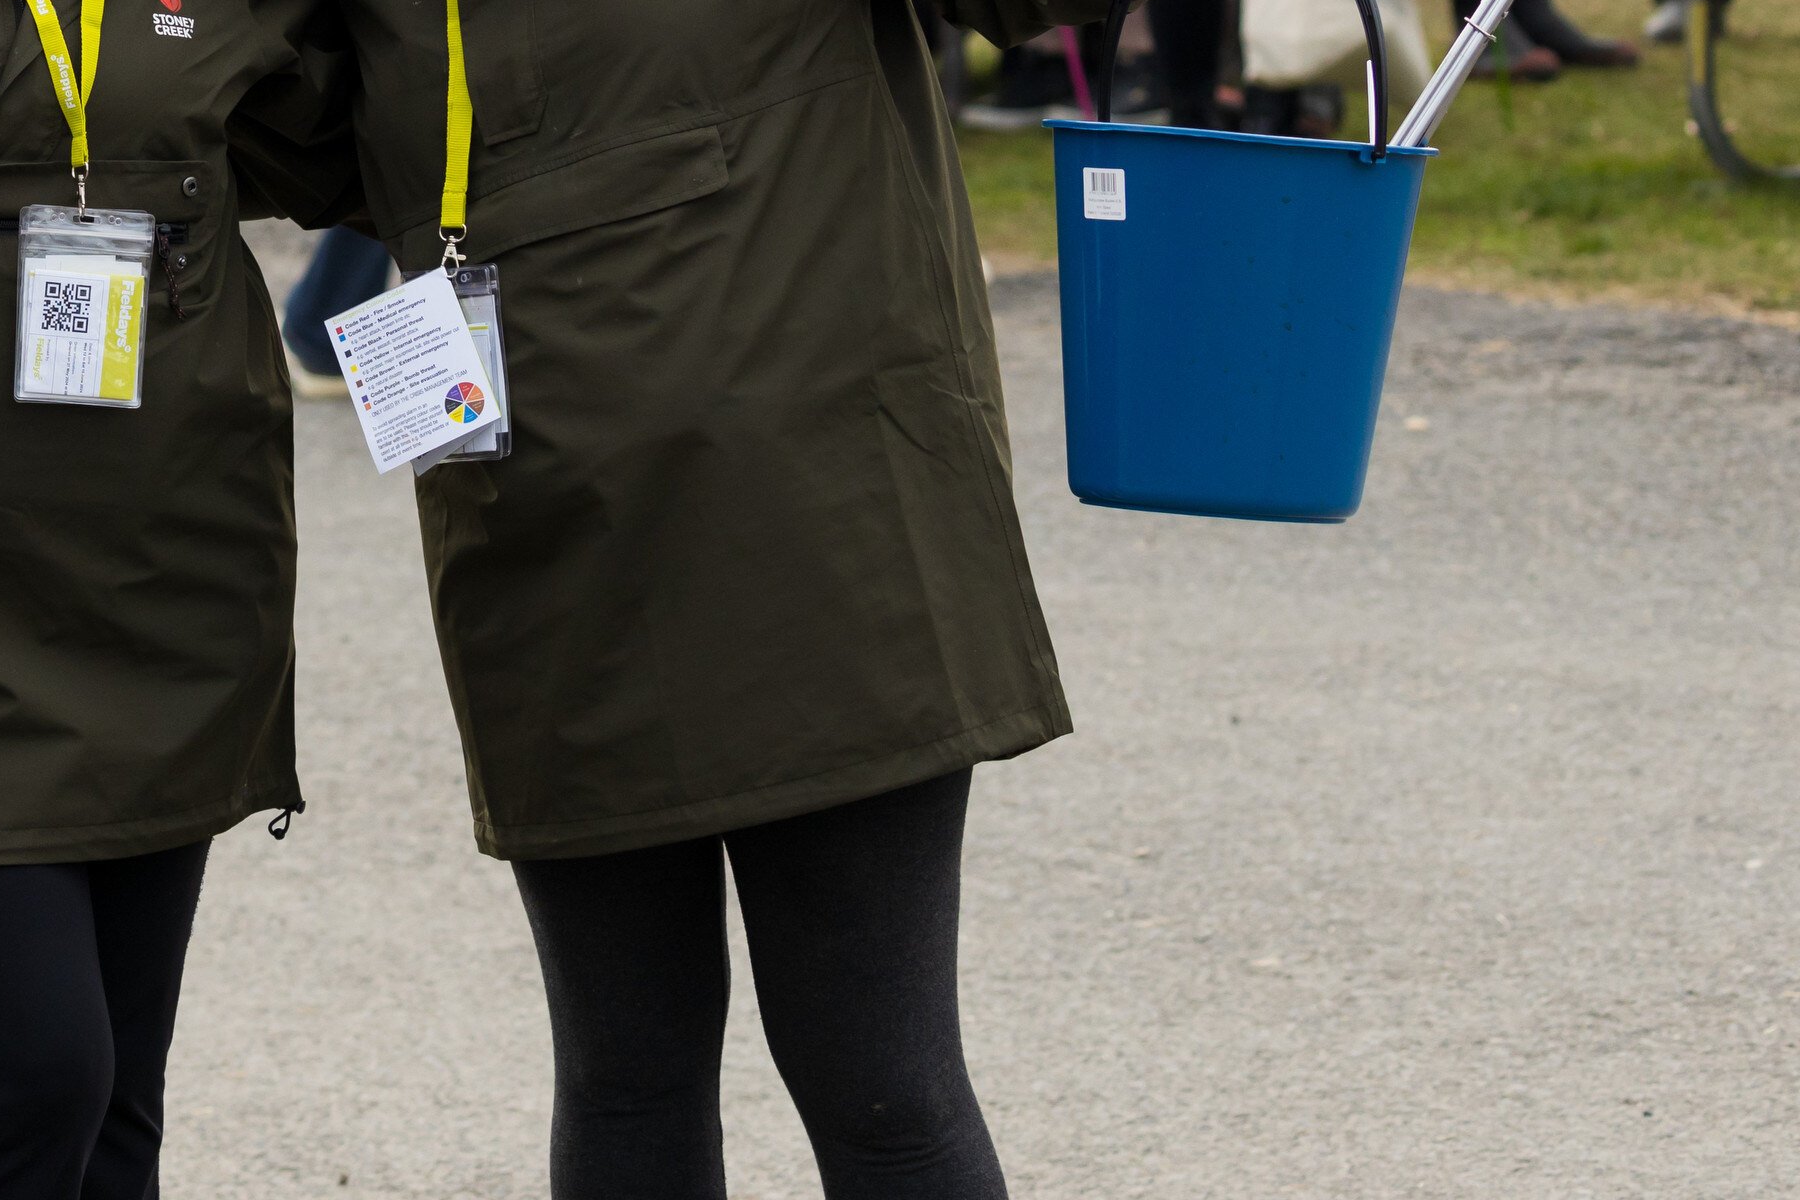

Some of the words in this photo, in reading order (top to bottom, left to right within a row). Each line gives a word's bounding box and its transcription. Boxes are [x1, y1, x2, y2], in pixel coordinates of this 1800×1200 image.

[152, 13, 195, 29] STONEY
[154, 25, 193, 39] CREEK
[114, 279, 135, 350] Fieldays
[344, 319, 359, 329] Code
[359, 314, 370, 323] Red
[373, 308, 384, 316] Fire
[387, 298, 405, 309] Smoke
[348, 327, 362, 337] Code
[362, 322, 374, 330] Blue
[377, 311, 398, 323] Medical
[398, 298, 426, 315] emergency
[353, 343, 367, 352] Code
[367, 336, 382, 346] Black
[386, 323, 408, 337] Personal
[409, 316, 424, 326] threat
[359, 358, 373, 368] Code
[373, 350, 390, 361] Yellow
[393, 339, 413, 351] Internal
[413, 327, 442, 343] emergency
[33, 338, 44, 377] Fieldays
[365, 373, 379, 383] Code
[379, 365, 396, 376] Brown
[399, 353, 420, 367] External
[421, 341, 450, 357] emergency
[370, 388, 384, 398] Code
[384, 380, 401, 392] Purple
[404, 371, 420, 382] Bomb
[420, 364, 436, 374] threat
[371, 409, 384, 417] ONLY
[383, 403, 395, 412] USED
[424, 375, 455, 393] MANAGEMENT
[455, 369, 468, 378] TEAM
[373, 396, 387, 406] Code
[387, 387, 406, 400] Orange
[410, 380, 420, 388] Site
[420, 367, 448, 383] evacuation
